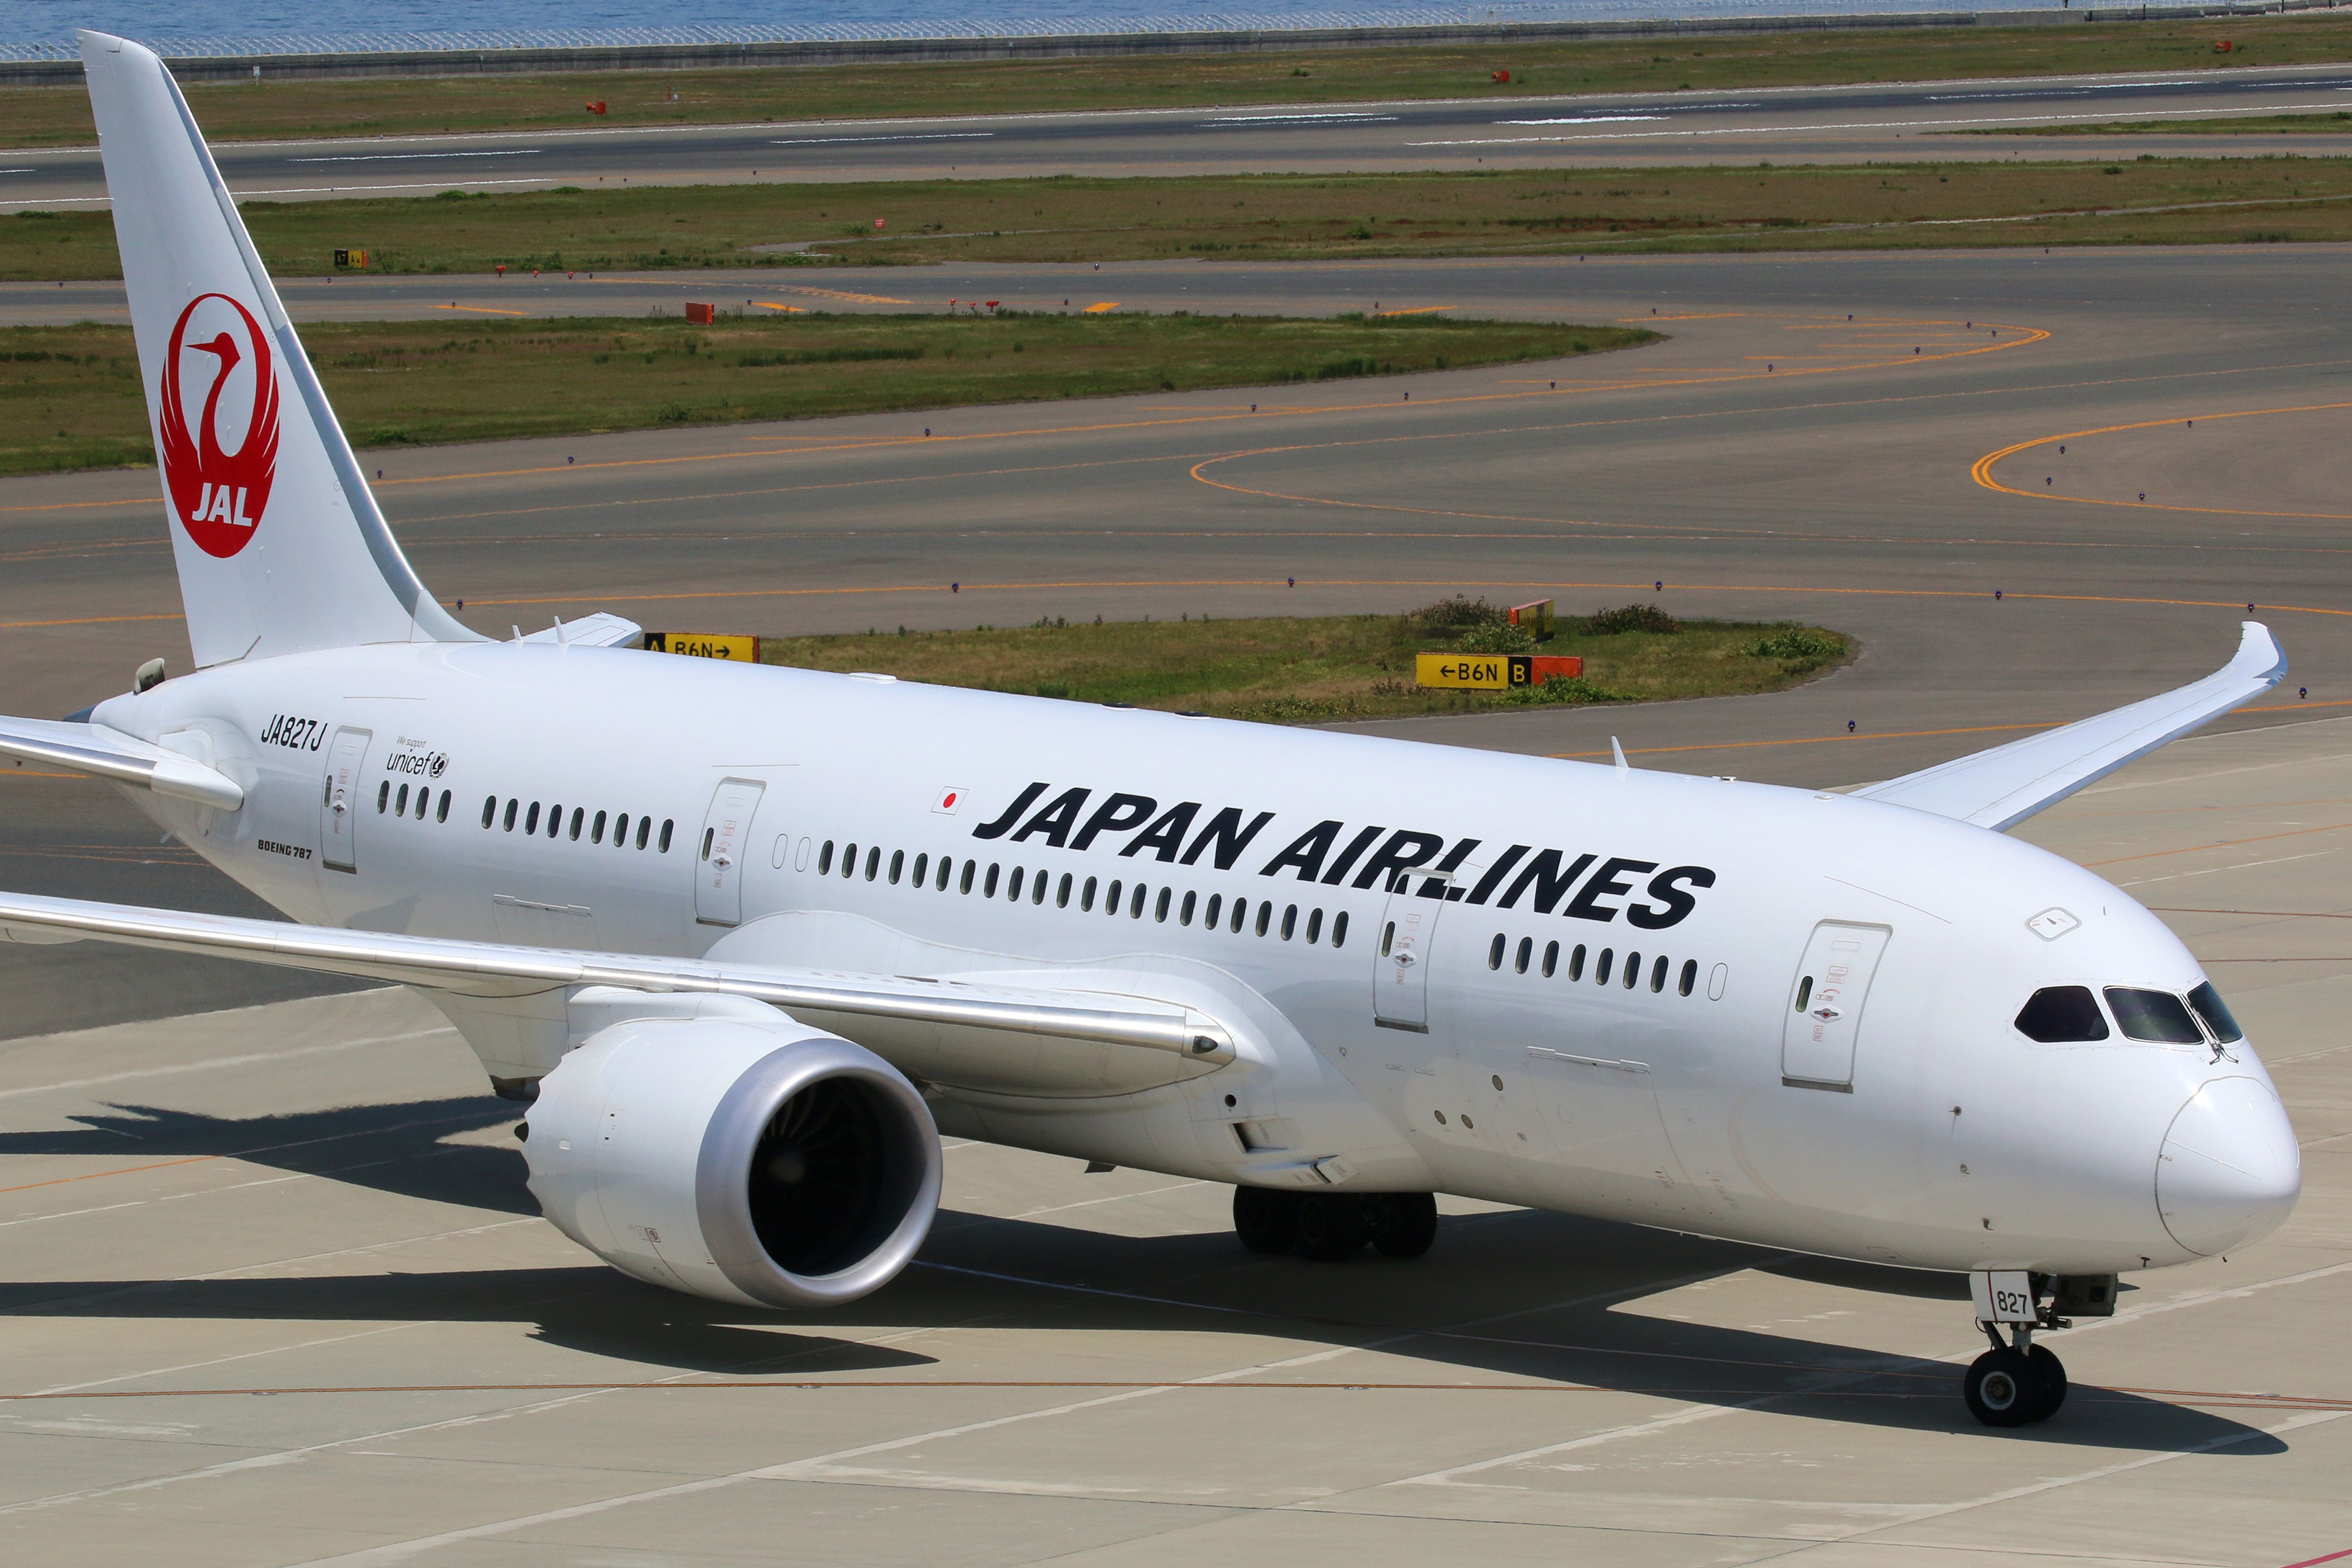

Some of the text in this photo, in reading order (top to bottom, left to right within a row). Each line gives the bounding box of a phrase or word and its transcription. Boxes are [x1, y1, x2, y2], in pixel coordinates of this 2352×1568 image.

[192, 482, 253, 527] JAL
[675, 641, 713, 658] B6N
[1458, 663, 1525, 682] B6N B
[261, 714, 328, 752] JA827J
[396, 735, 426, 749] We support
[386, 748, 435, 775] unicef
[258, 839, 312, 860] BOEING 787
[971, 781, 1716, 930] JAPAN AIRLINES
[1997, 1290, 2028, 1315] 827
